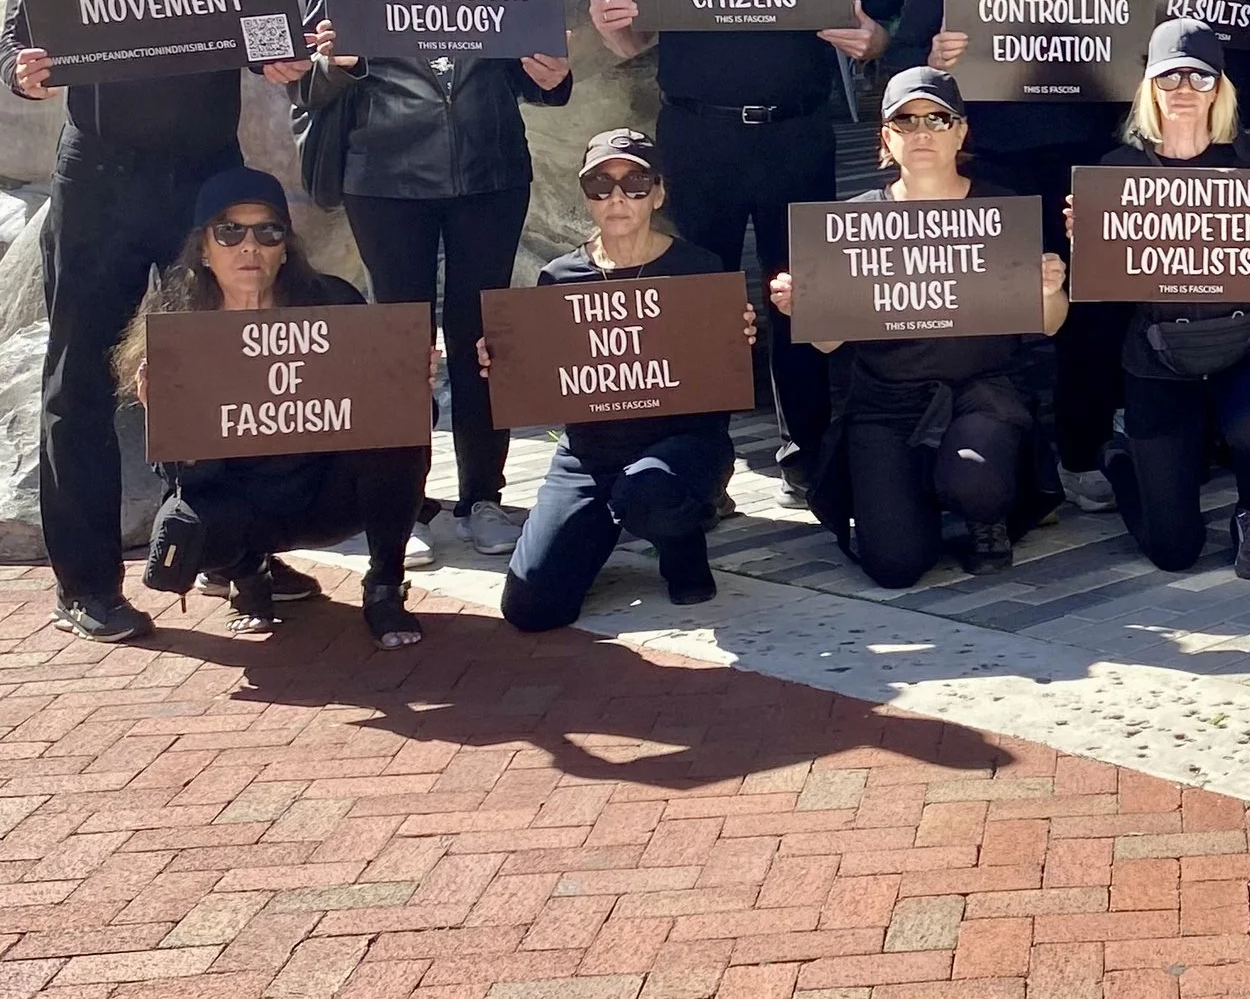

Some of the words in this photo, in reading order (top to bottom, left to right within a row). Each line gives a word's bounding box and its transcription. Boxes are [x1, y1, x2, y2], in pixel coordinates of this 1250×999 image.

[386, 4, 505, 32] IDEOLOGY
[714, 15, 734, 23] THIS
[743, 15, 776, 23] FASCISM
[417, 41, 438, 49] THIS
[448, 41, 482, 50] FASCISM
[993, 35, 1111, 62] EDUCATION
[1023, 85, 1041, 94] THIS
[1050, 86, 1080, 94] FASCISM
[826, 208, 1001, 242] DEMOLISHING
[842, 247, 895, 277] THE
[902, 244, 986, 275] WHITE
[874, 280, 959, 312] HOUSE
[1159, 285, 1179, 293] THIS
[1188, 285, 1223, 293] FASCISM
[564, 291, 628, 323] THIS
[635, 289, 660, 319] IS
[242, 320, 330, 357] SIGNS
[885, 322, 906, 331] THIS
[916, 320, 953, 329] FASCISM
[589, 326, 643, 358] NOT
[268, 361, 305, 395] OF
[559, 359, 680, 396] NORMAL
[221, 398, 351, 437] FASCISM
[589, 403, 610, 412] THIS
[622, 399, 660, 410] FASCISM
